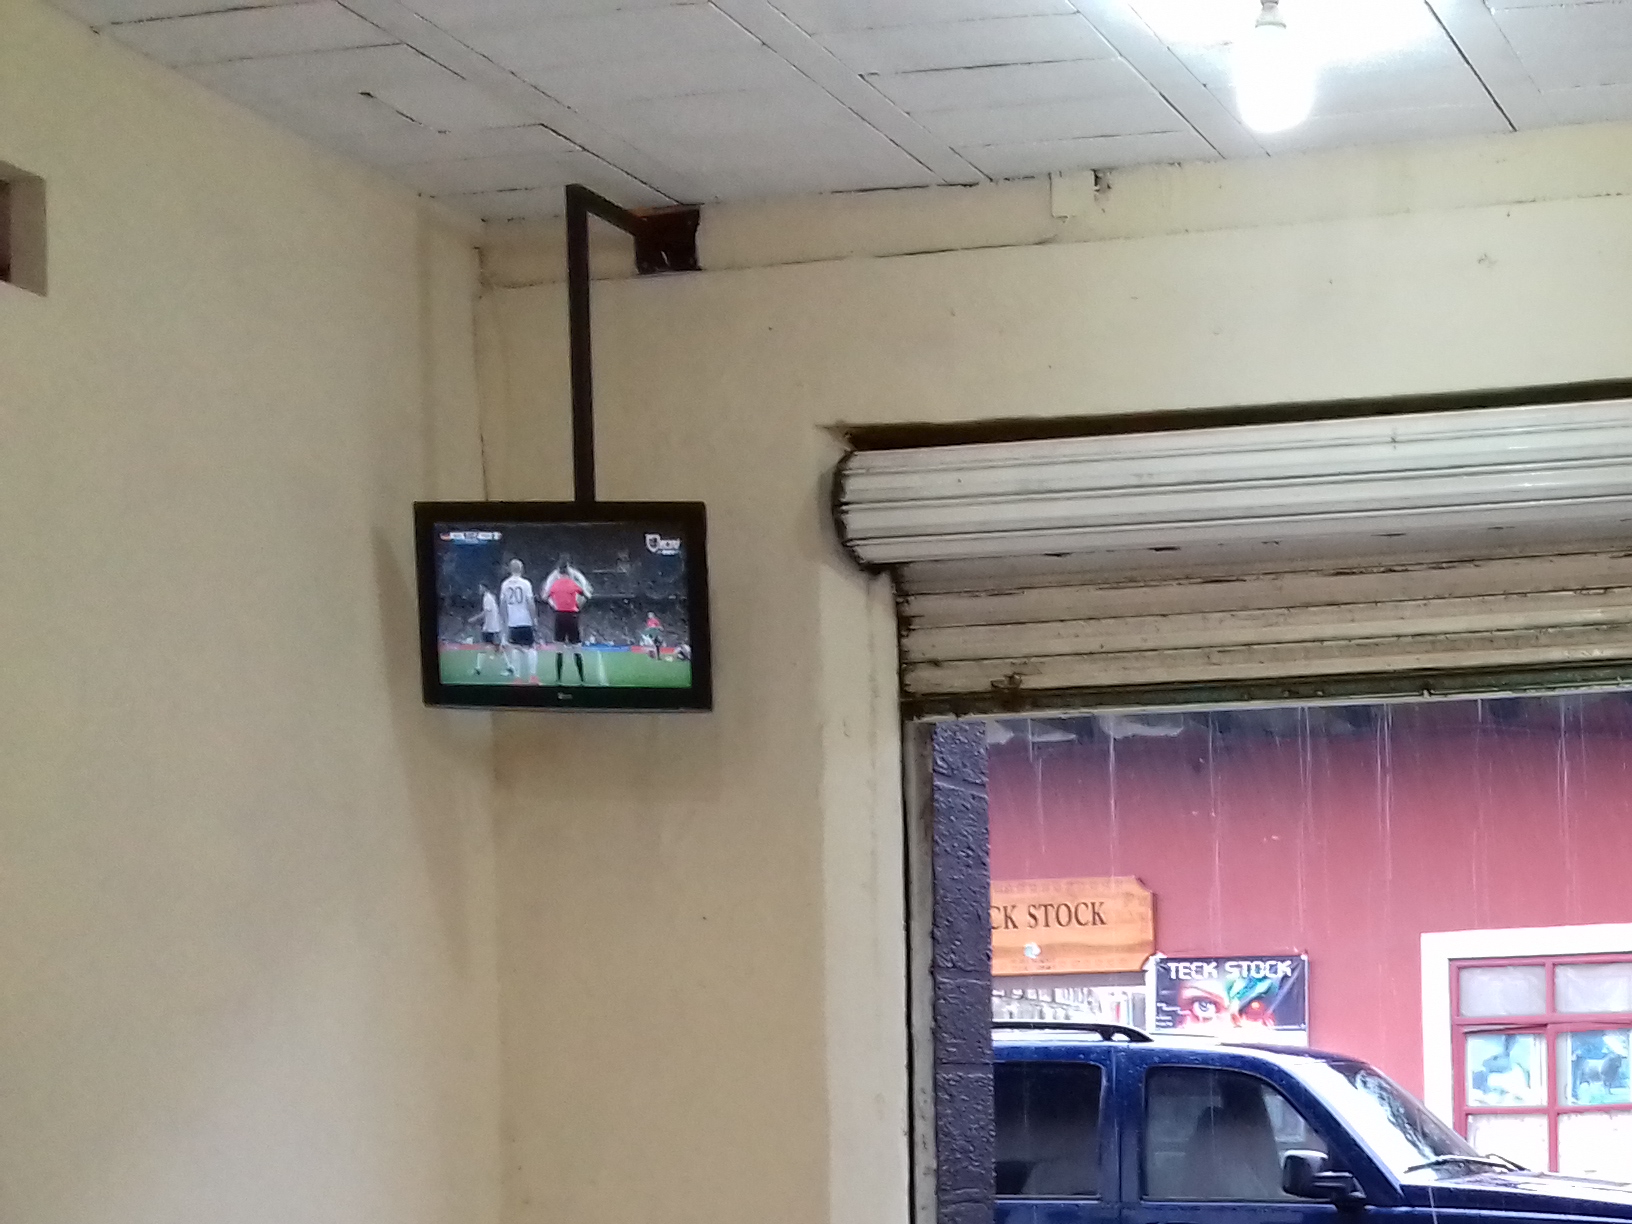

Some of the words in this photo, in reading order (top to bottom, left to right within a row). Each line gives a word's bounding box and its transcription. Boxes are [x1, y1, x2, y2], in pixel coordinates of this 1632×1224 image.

[507, 586, 524, 605] 20
[1027, 901, 1107, 929] STOCK
[1168, 962, 1218, 980] TECK
[1224, 960, 1292, 978] STOCK
